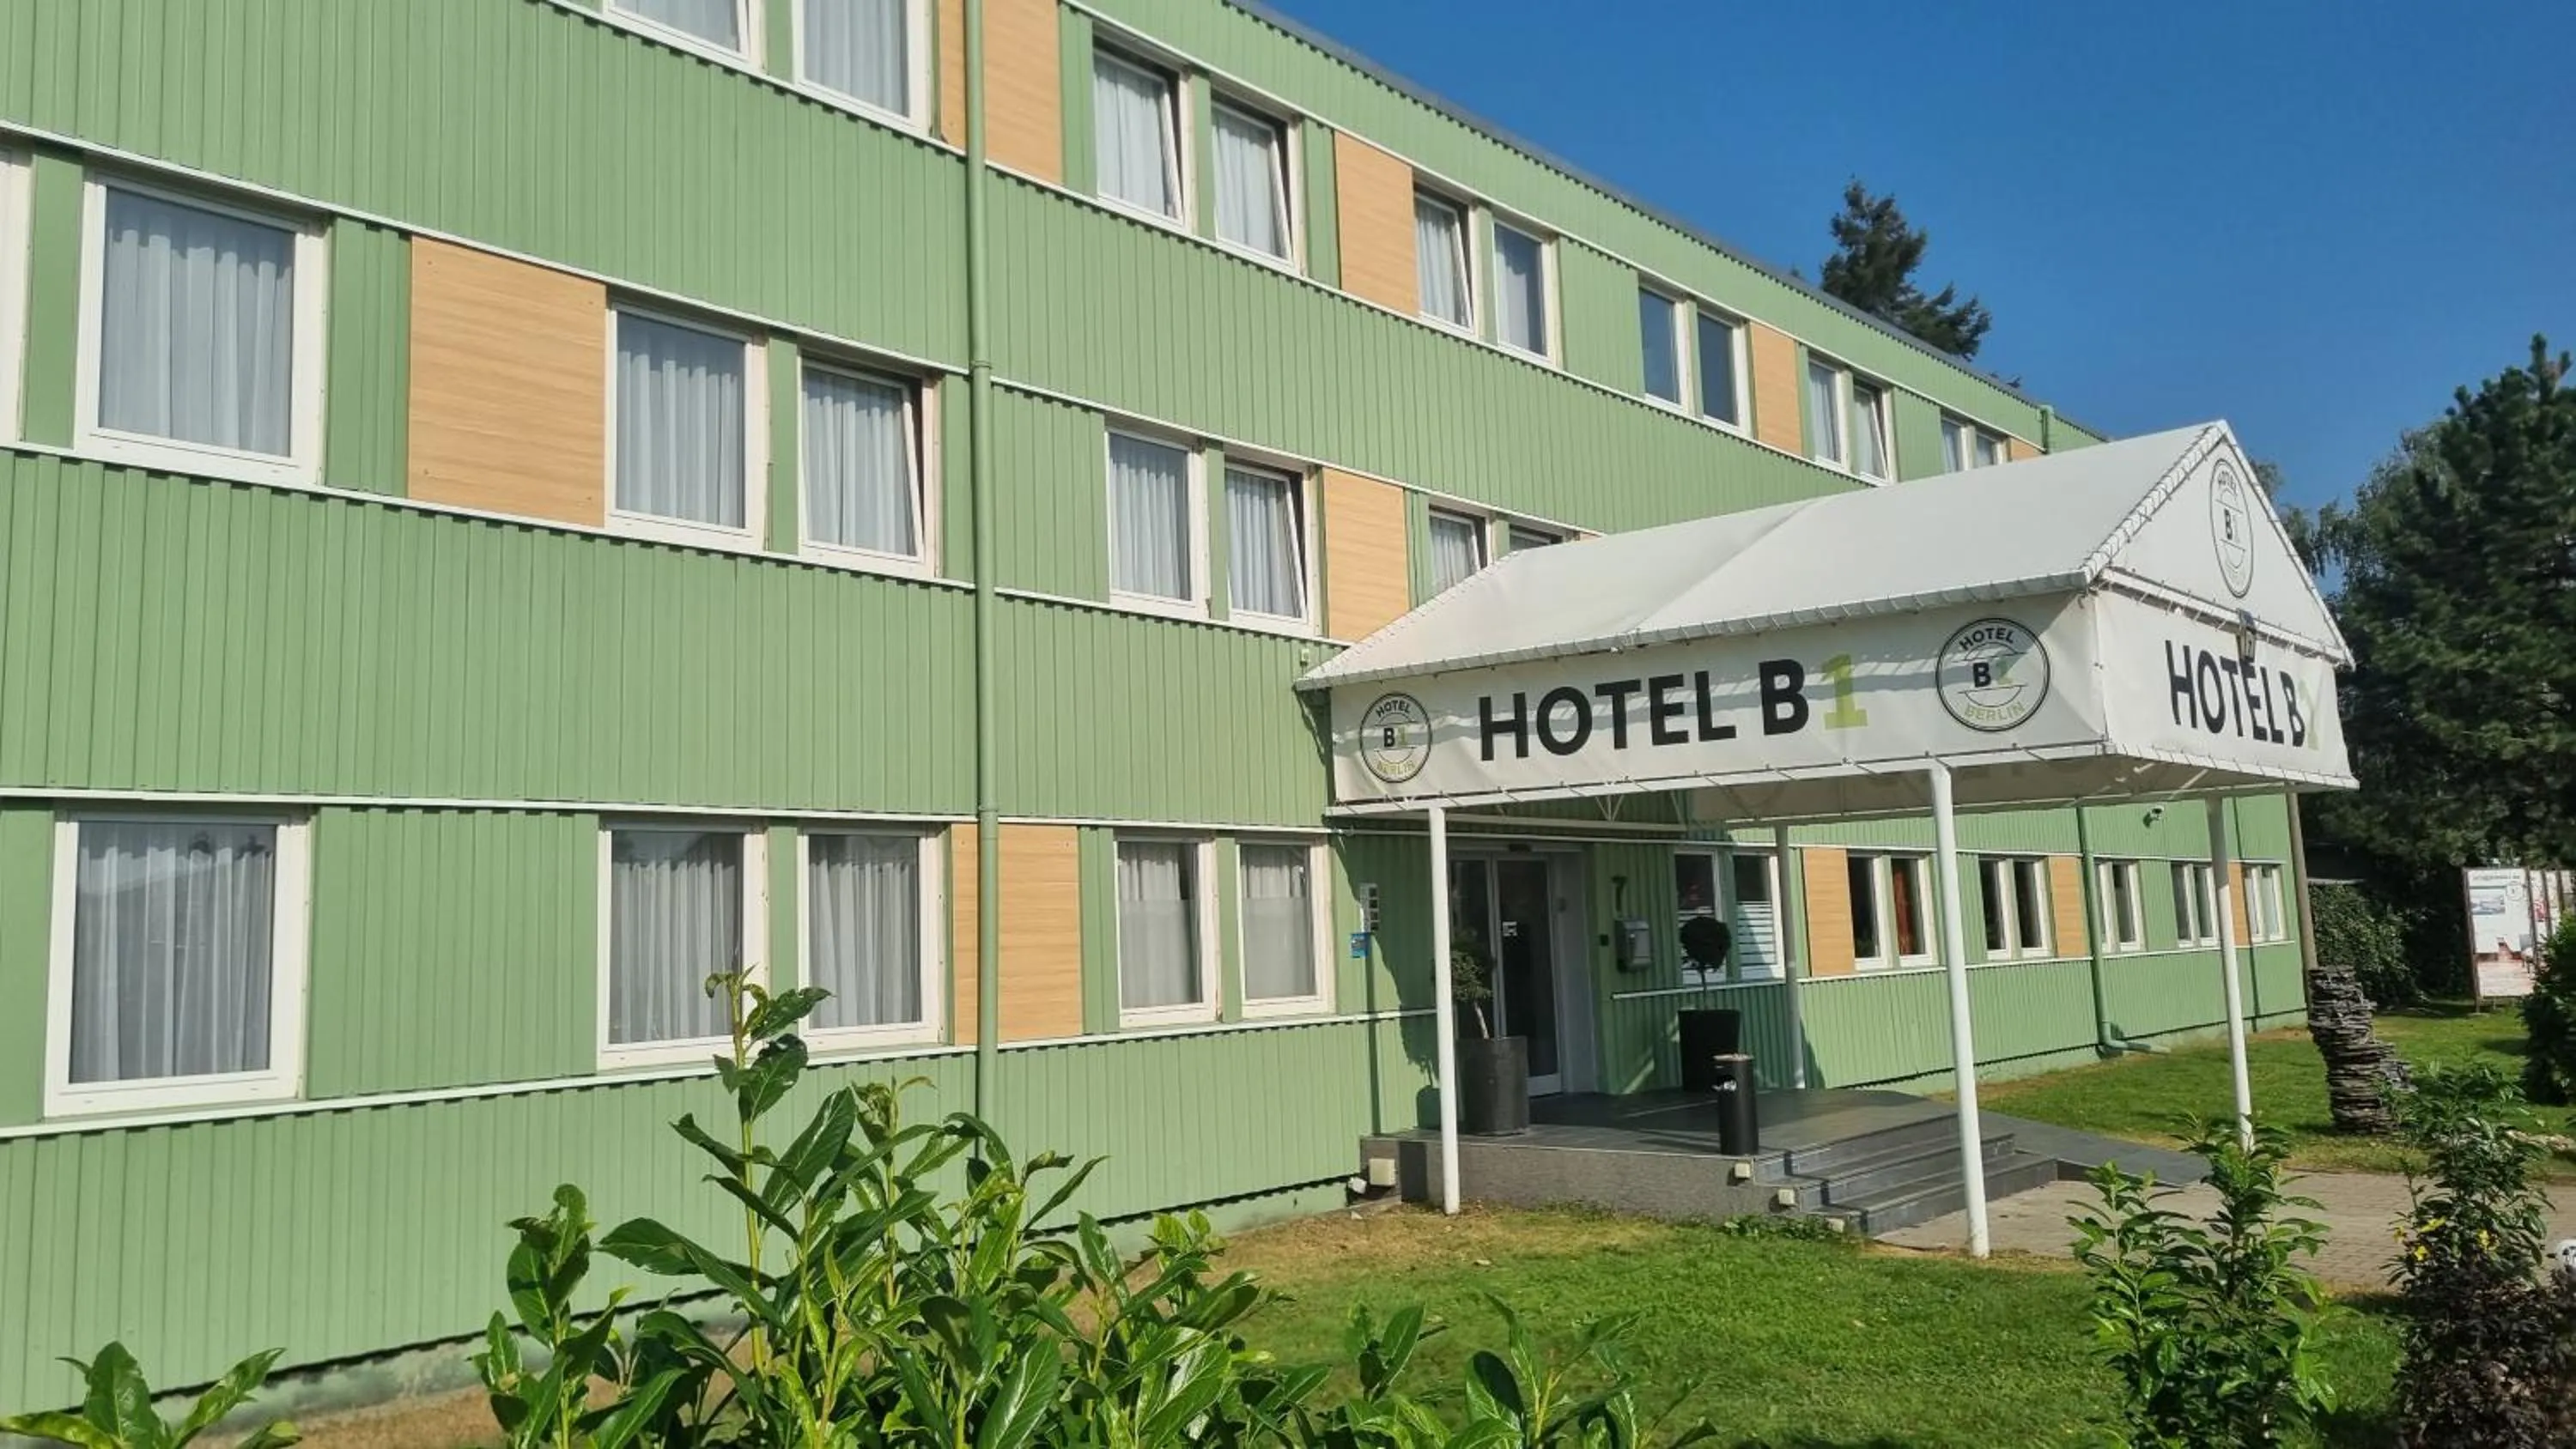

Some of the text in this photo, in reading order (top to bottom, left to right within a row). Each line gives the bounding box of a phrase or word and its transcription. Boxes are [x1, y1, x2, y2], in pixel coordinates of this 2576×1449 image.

[1959, 627, 2015, 651] HOTEL
[2165, 640, 2284, 745] HOTEL
[1376, 700, 1411, 718] HOTEL
[1479, 652, 1868, 761] HOTEL B1
[1964, 700, 2026, 721] BERLIN
[1383, 726, 1407, 747] B1
[1611, 875, 1628, 914] 7
